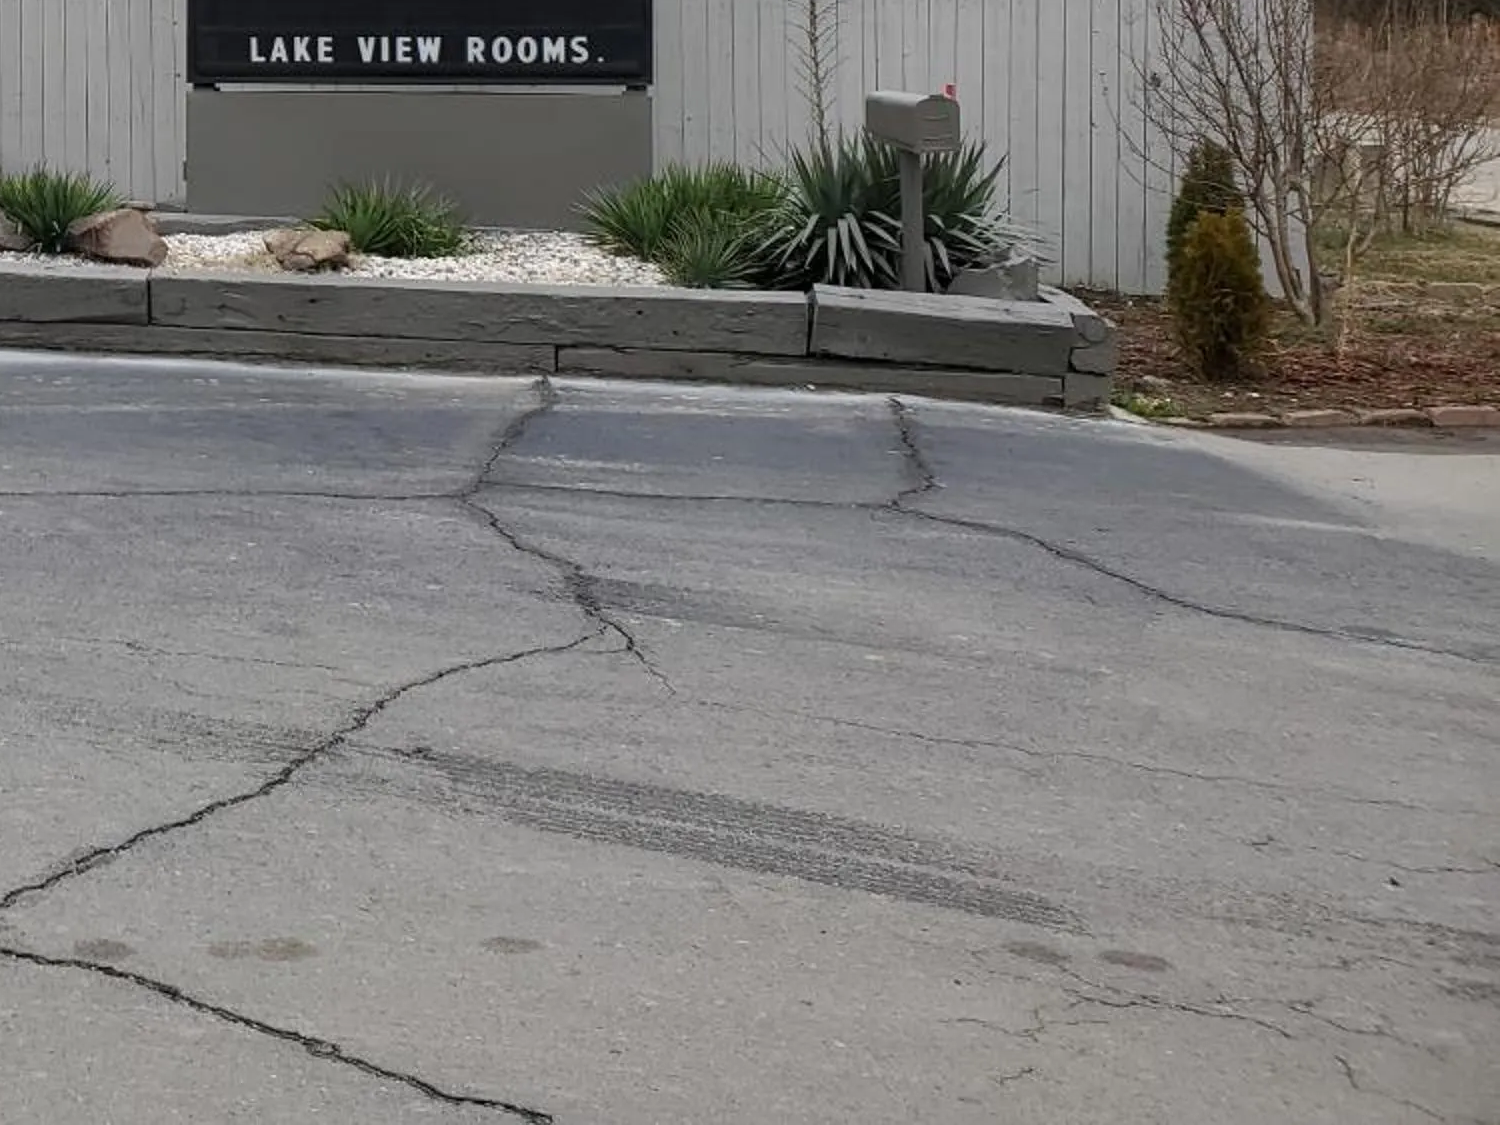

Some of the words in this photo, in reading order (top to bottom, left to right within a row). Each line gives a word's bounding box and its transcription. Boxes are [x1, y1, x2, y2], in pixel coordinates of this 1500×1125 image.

[249, 36, 334, 63] LAKE
[358, 36, 442, 63] VIEW
[467, 36, 605, 63] ROOMS.
